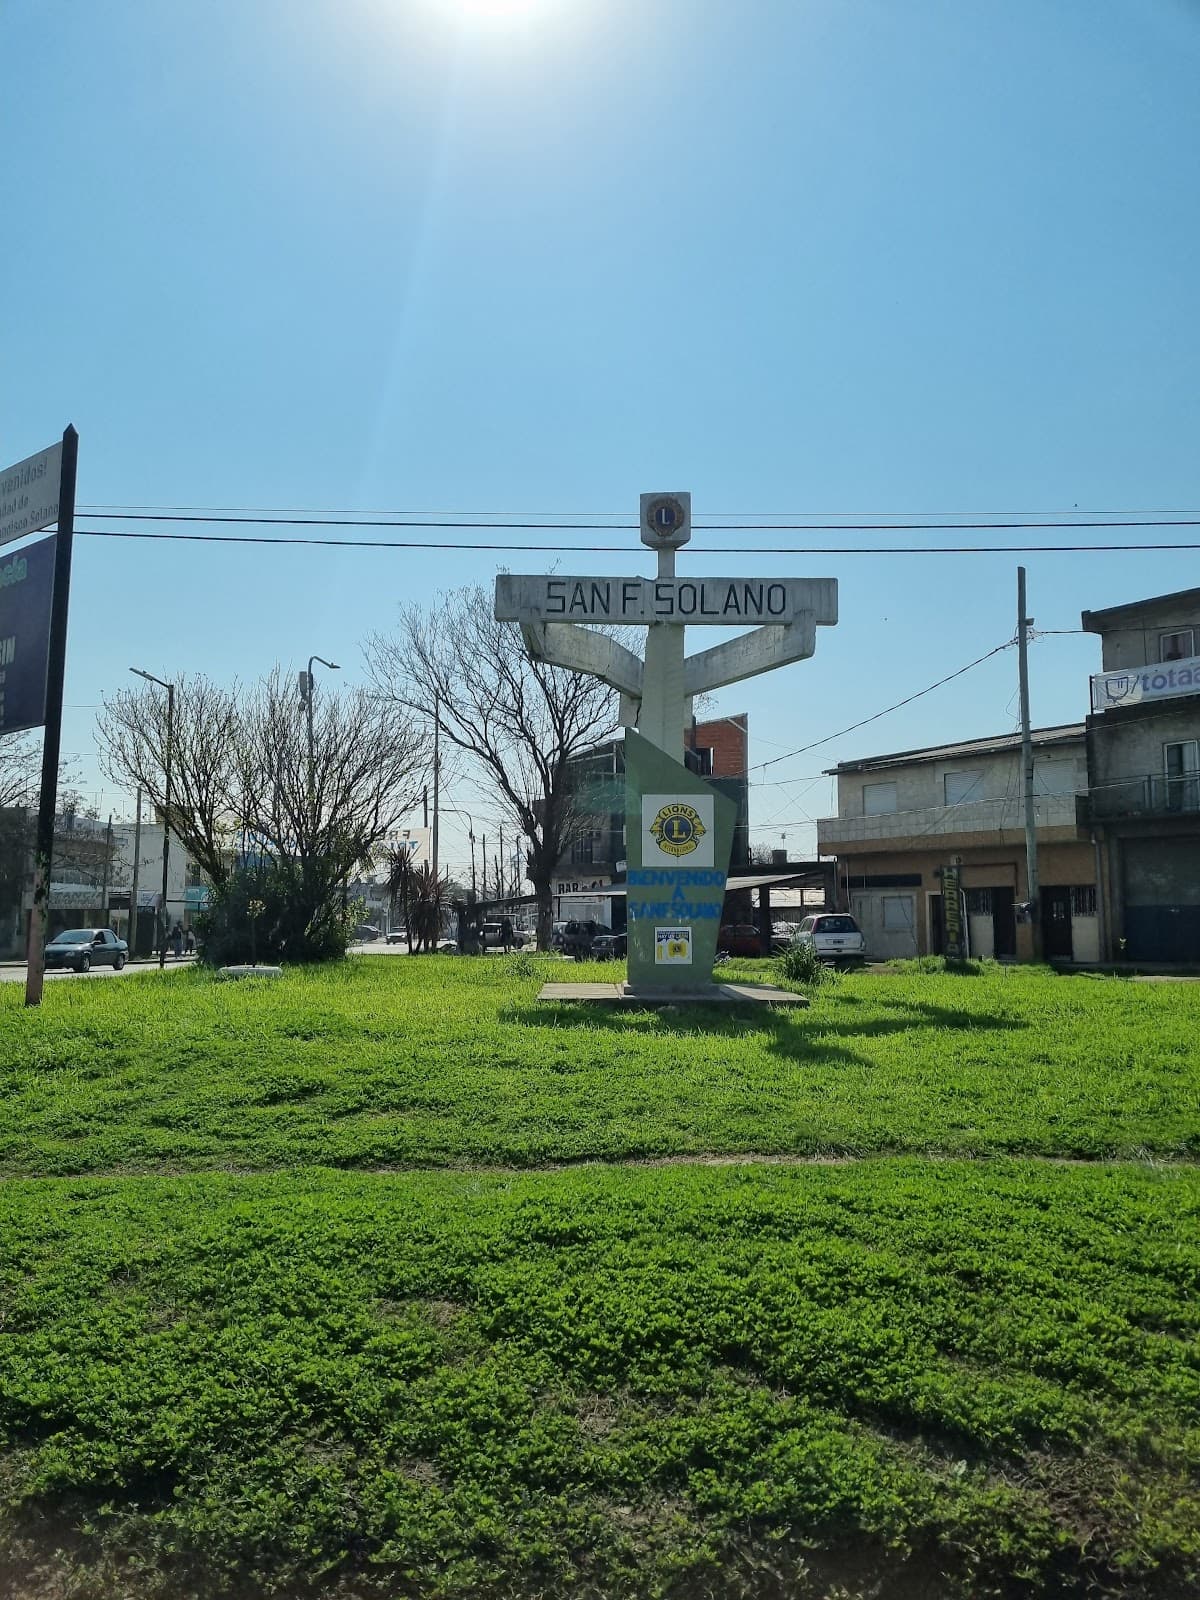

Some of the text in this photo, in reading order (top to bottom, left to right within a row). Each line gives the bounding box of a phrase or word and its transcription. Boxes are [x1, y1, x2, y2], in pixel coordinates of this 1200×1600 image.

[546, 581, 787, 615] SAN F. SOLANO
[662, 805, 694, 818] LIONS
[671, 819, 687, 839] L
